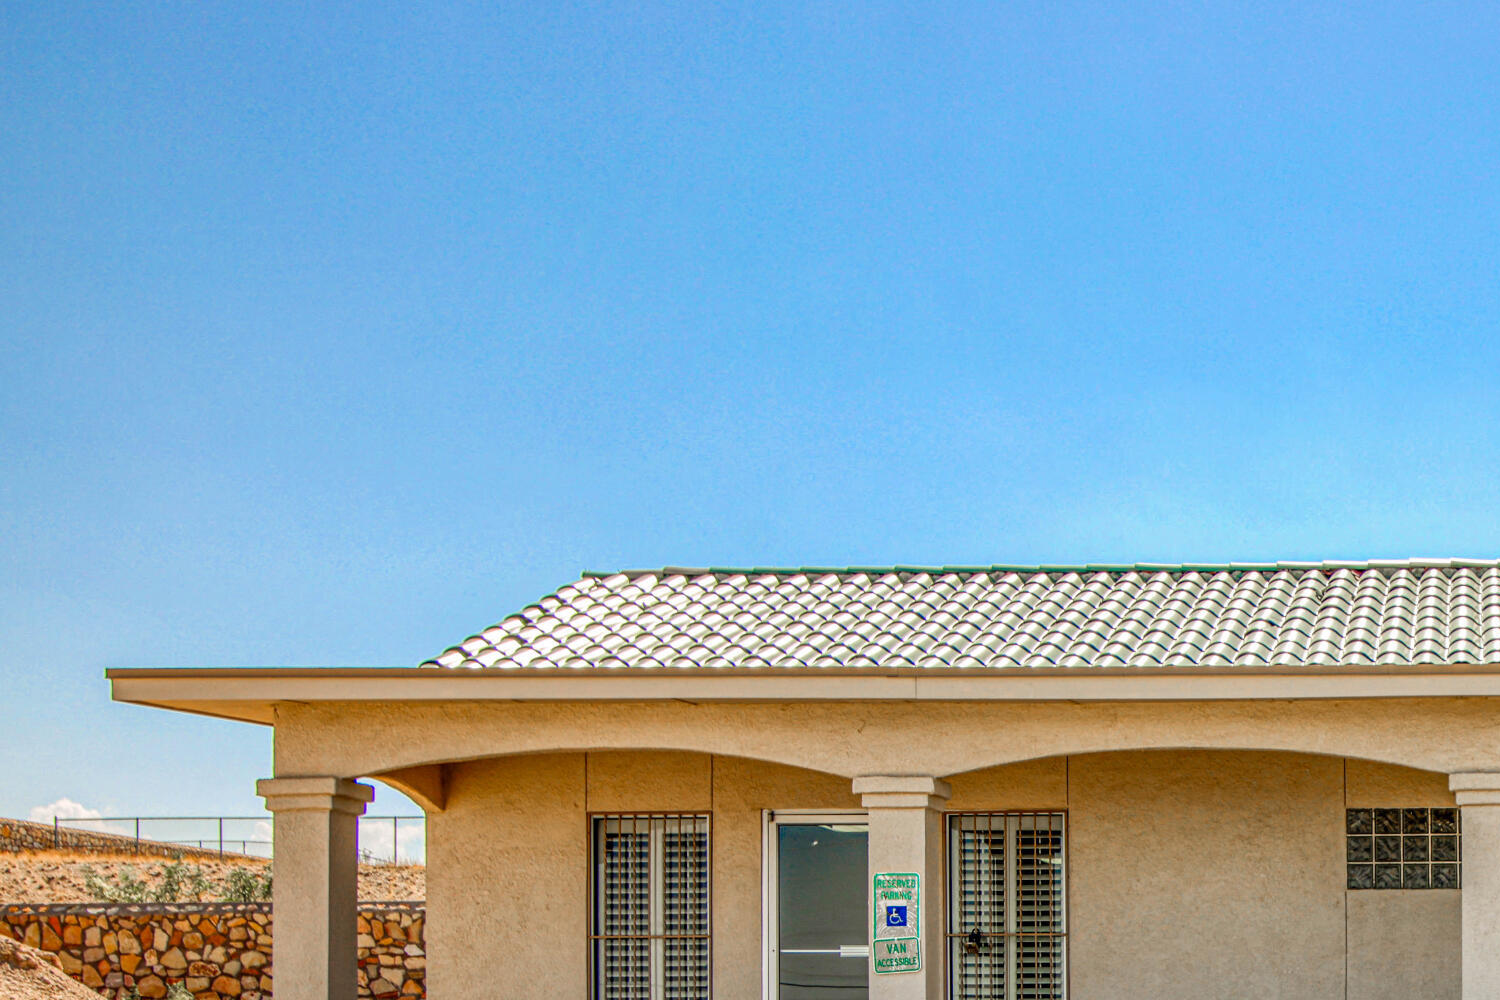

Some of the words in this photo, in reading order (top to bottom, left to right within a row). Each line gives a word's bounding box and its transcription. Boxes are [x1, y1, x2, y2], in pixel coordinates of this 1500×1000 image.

[877, 879, 916, 889] RESERVED
[880, 891, 912, 900] PARKING
[886, 943, 907, 954] VAN
[877, 957, 917, 968] ACCESSIBLE
